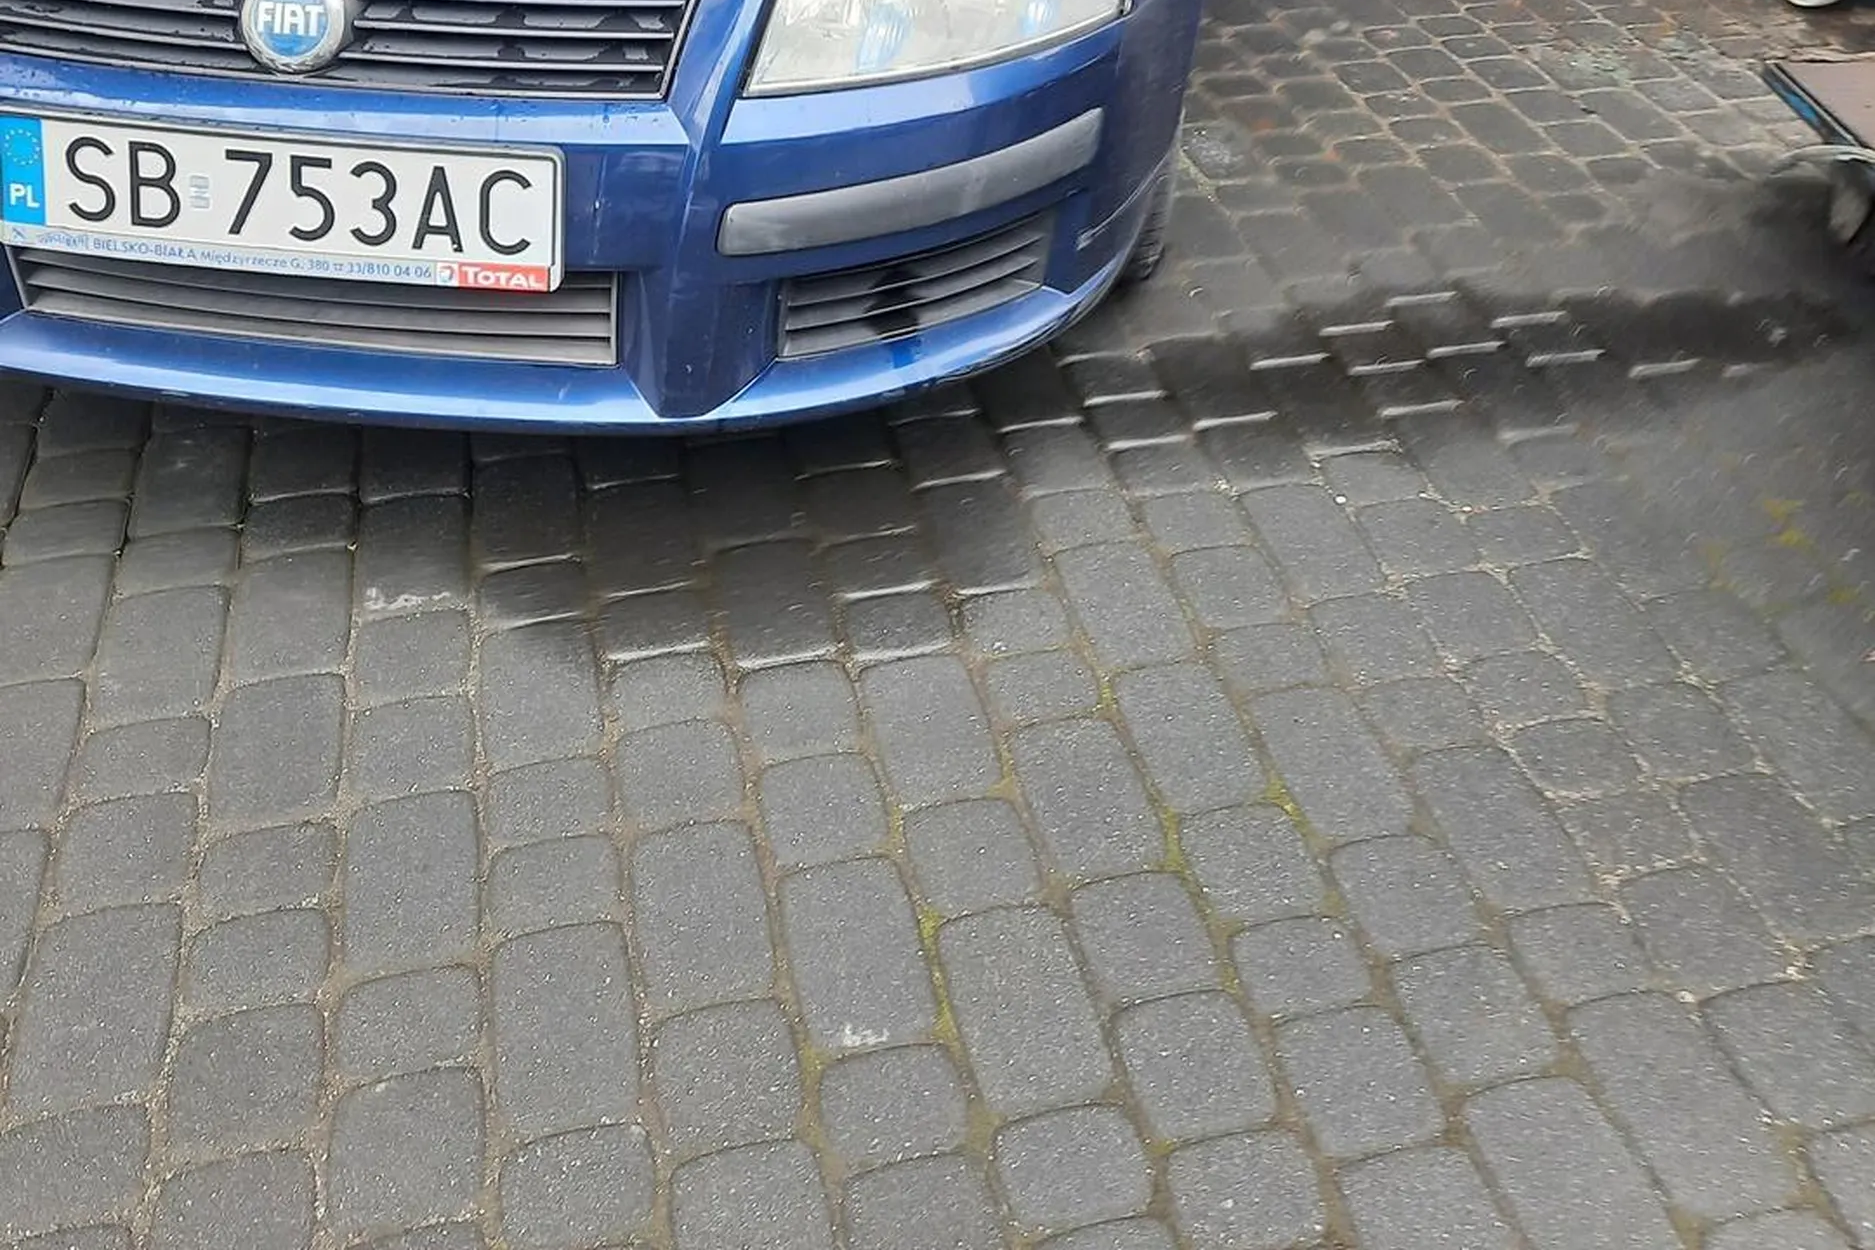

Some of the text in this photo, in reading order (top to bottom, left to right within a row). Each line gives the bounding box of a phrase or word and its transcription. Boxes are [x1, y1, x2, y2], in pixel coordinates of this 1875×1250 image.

[256, 0, 325, 37] FIAT
[9, 182, 40, 208] PL
[65, 136, 532, 256] SB 753AC
[93, 238, 197, 260] BIELSKO-BIAŁA
[308, 258, 330, 271] 380
[393, 265, 411, 278] 04
[414, 266, 432, 279] 06
[459, 269, 544, 288] TOTAL
